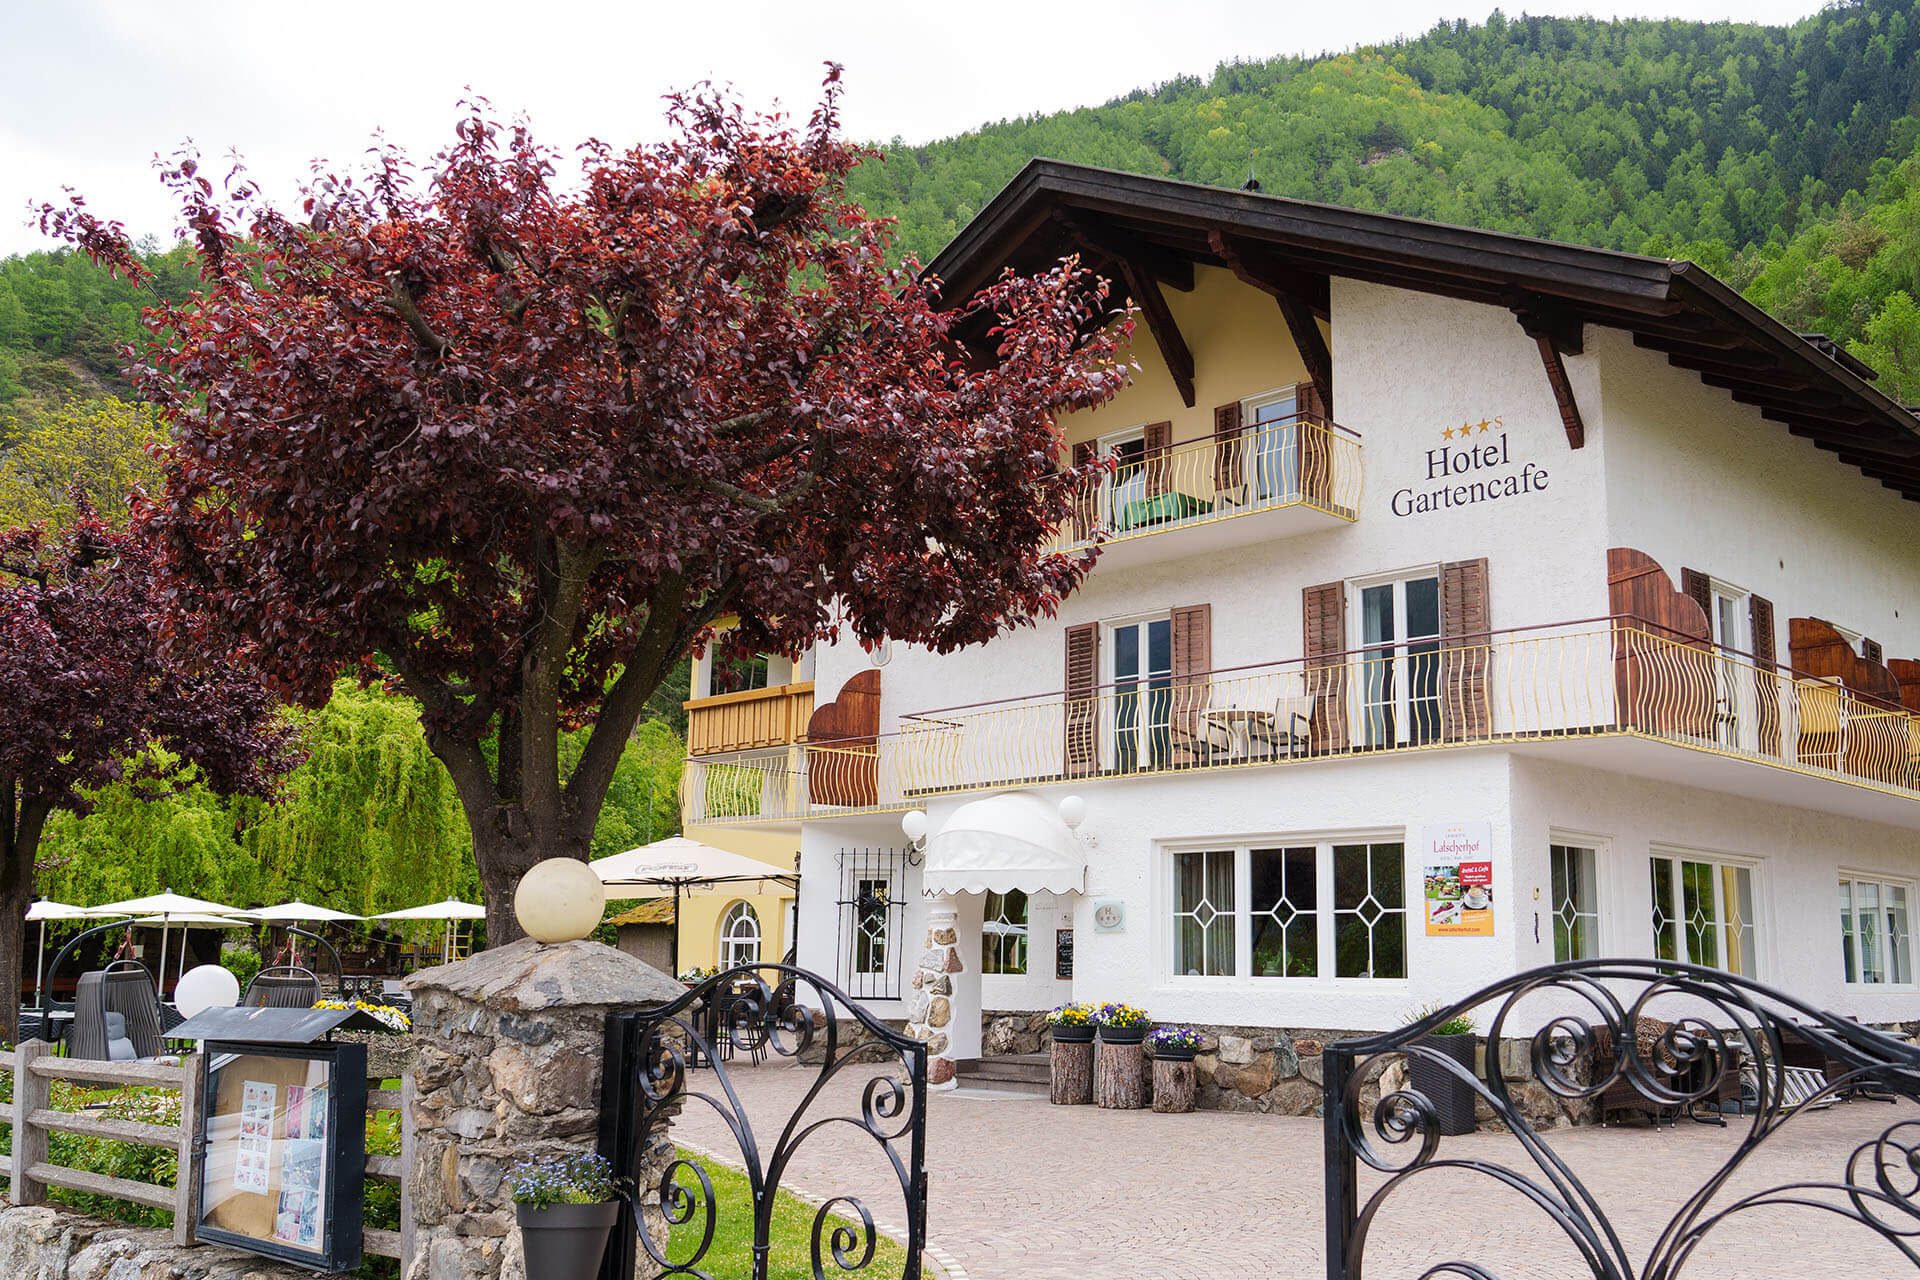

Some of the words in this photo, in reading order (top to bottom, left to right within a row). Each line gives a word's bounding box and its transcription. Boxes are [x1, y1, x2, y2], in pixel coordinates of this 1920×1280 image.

[1494, 416, 1504, 430] S
[1425, 433, 1510, 480] Hotel
[1391, 463, 1549, 518] Gartencafe
